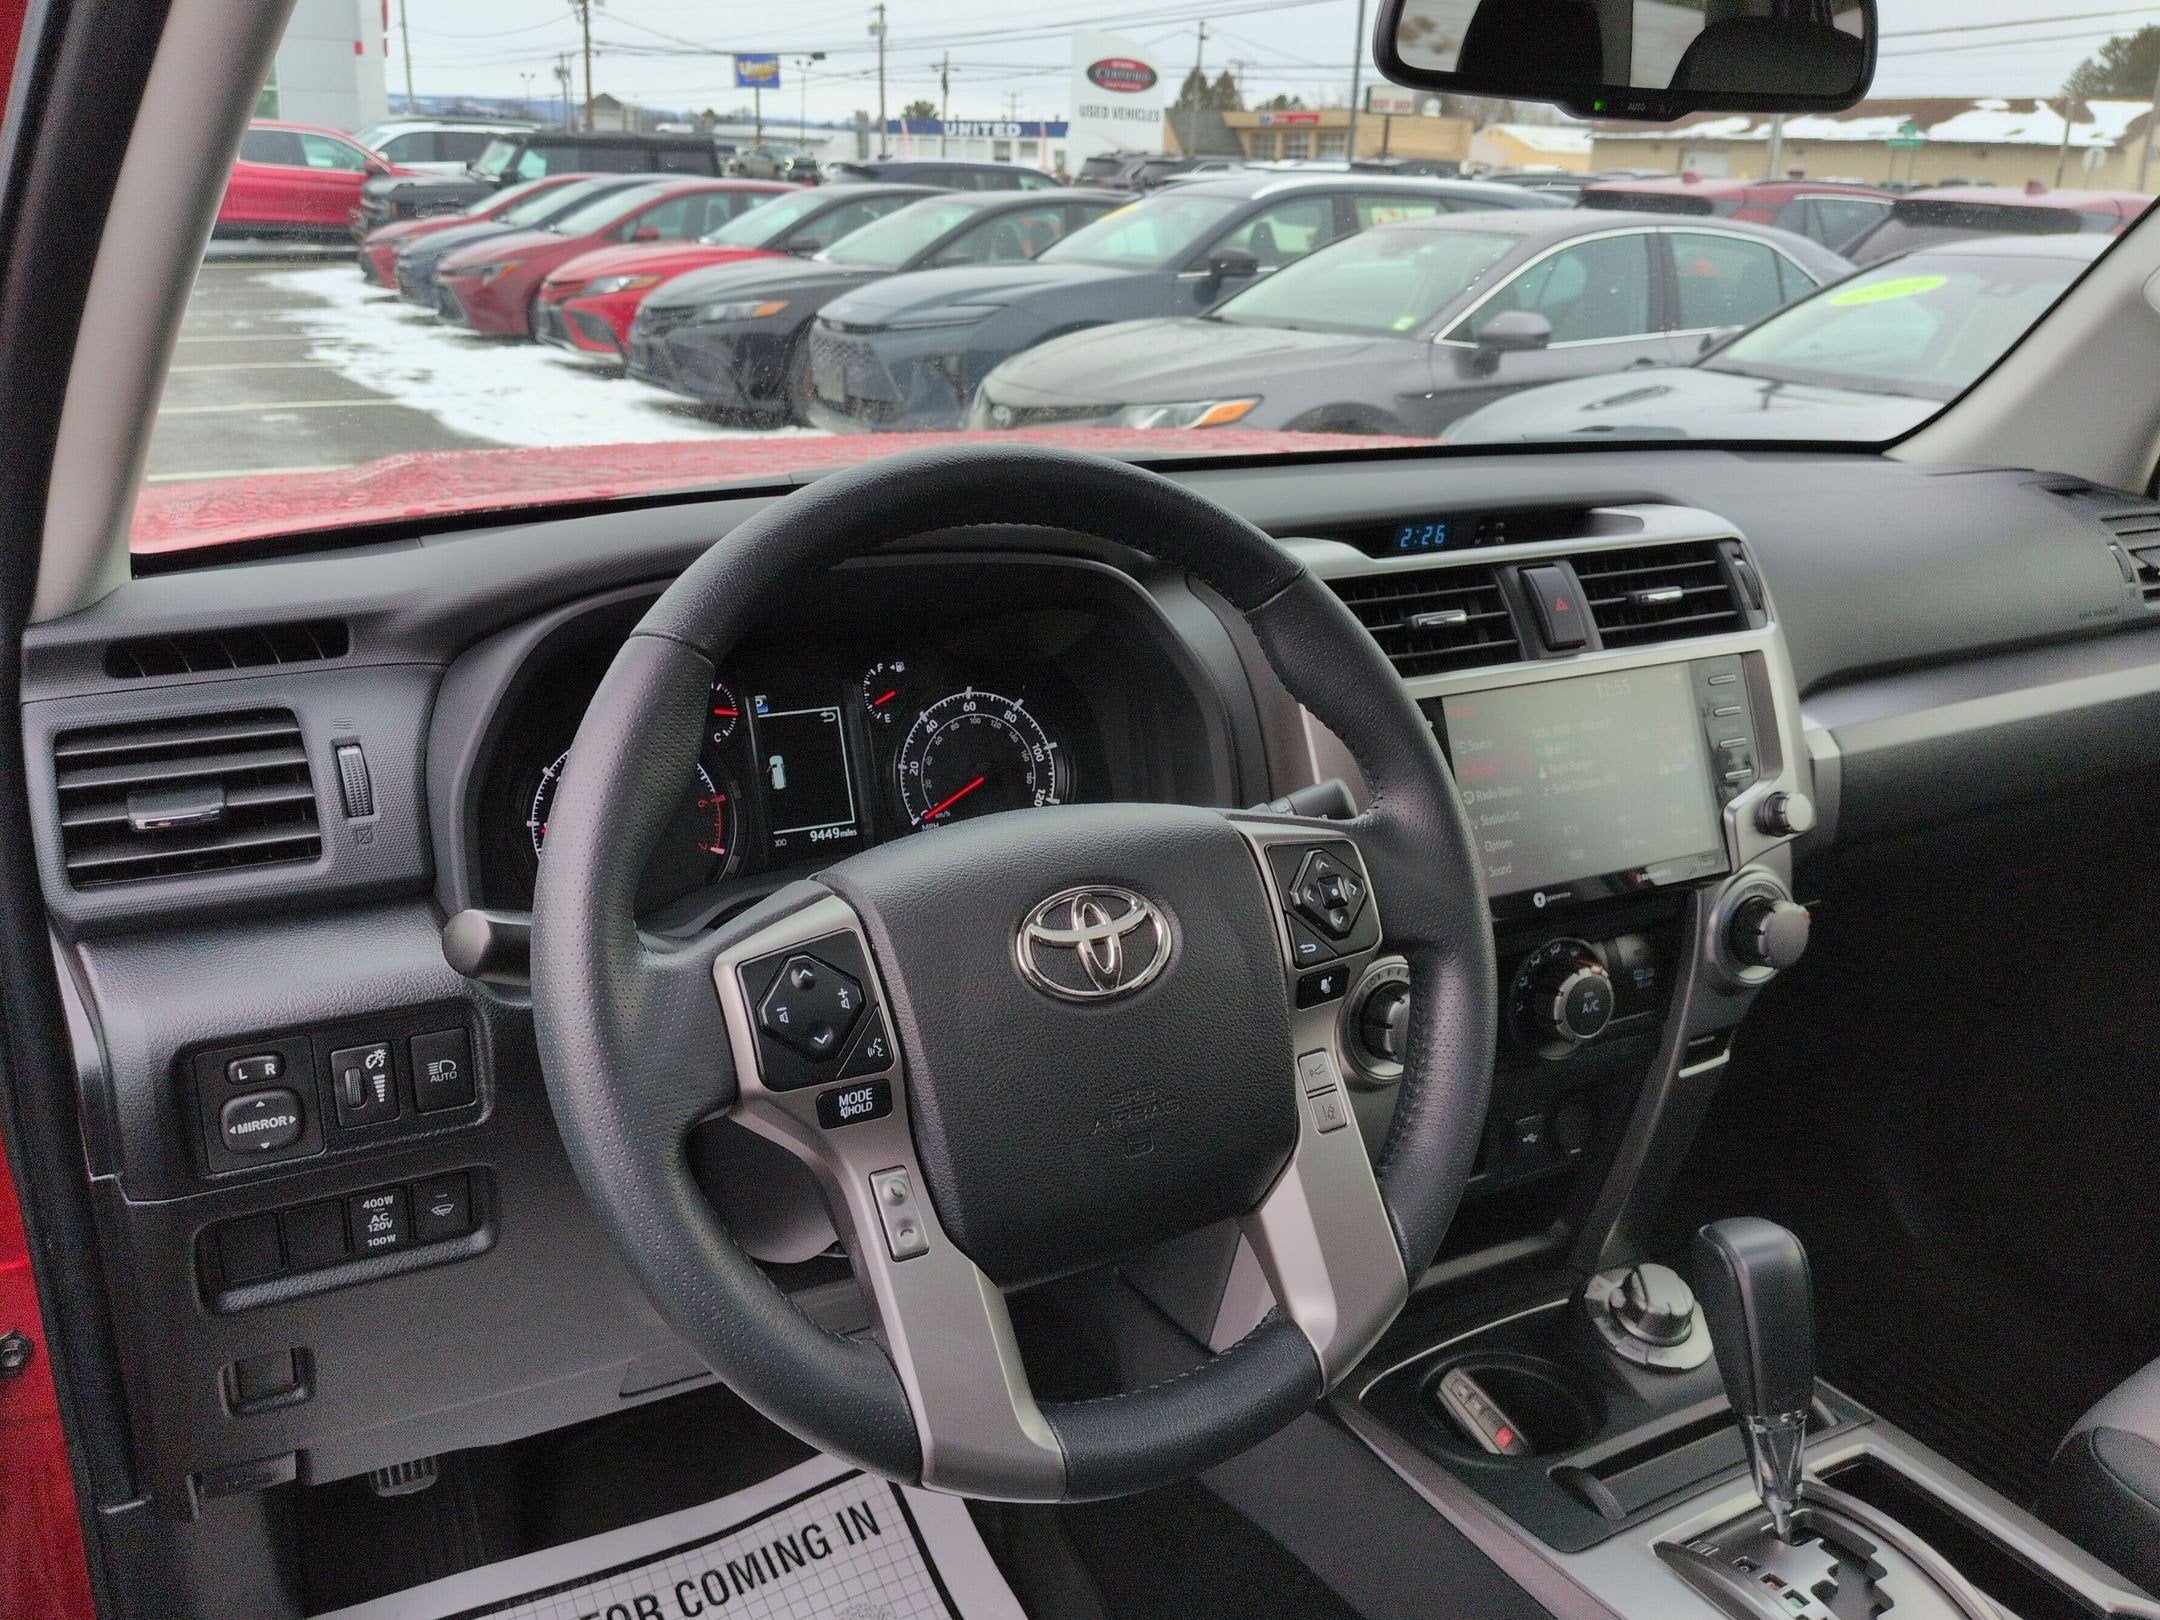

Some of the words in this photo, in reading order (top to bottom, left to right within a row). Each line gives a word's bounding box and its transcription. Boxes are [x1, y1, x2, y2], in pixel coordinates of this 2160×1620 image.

[1078, 103, 1110, 119] USED
[1112, 105, 1161, 122] VEHICLES
[1627, 102, 1646, 112] AUTO
[943, 122, 1022, 137] UNITED
[1400, 525, 1446, 548] 2:26
[877, 663, 884, 672] F
[1596, 679, 1631, 697] 11:55
[963, 701, 976, 712] 60
[884, 714, 891, 723] E
[969, 717, 981, 725] 100
[1003, 710, 1017, 723] 80
[926, 719, 938, 734] 40
[990, 719, 1002, 729] 120
[713, 733, 722, 743] C
[1031, 742, 1044, 763] 100
[909, 761, 919, 776] 20
[1033, 788, 1046, 807] 120
[1475, 789, 1498, 802] Radio
[1480, 811, 1506, 827] Station
[1506, 809, 1521, 822] List
[1484, 838, 1514, 852] Options
[1488, 863, 1512, 878] Sound
[1582, 1000, 1600, 1014] A/C
[238, 1068, 248, 1080] L
[265, 1063, 276, 1075] R
[430, 1071, 457, 1083] AUTO
[838, 1088, 873, 1107] MODE
[848, 1101, 873, 1115] HOLD
[237, 1115, 288, 1134] MIRROR
[362, 1195, 394, 1209] 400W
[371, 1212, 389, 1224] AC
[367, 1220, 393, 1232] 120V
[367, 1234, 396, 1247] 100W
[674, 1523, 832, 1617] COMING
[835, 1500, 881, 1546] IN
